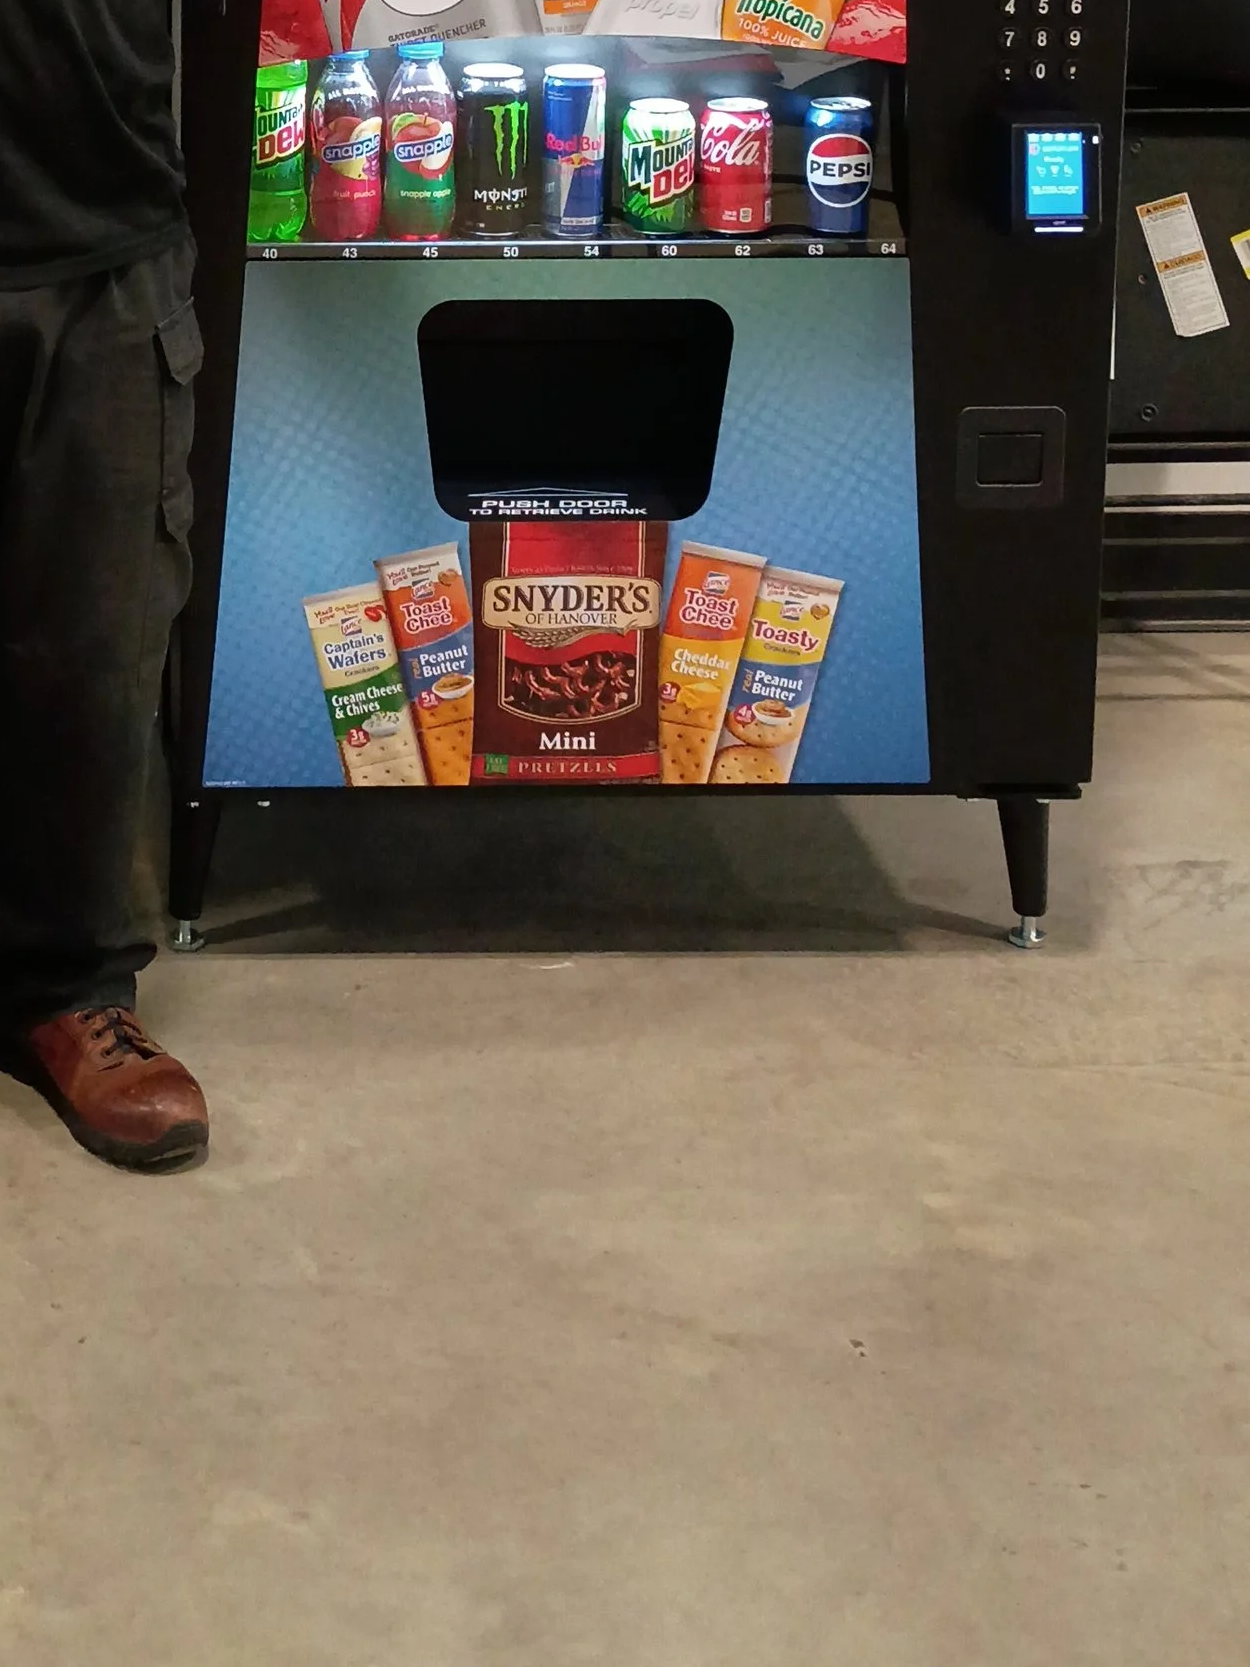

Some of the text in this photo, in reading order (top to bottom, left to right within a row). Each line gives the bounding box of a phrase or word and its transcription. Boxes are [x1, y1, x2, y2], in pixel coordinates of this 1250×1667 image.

[388, 25, 436, 43] GATORADE
[430, 18, 487, 42] QUENCHER
[738, 17, 809, 48] 100% JUICE
[1005, 30, 1081, 47] 7 8 9
[1035, 63, 1046, 79] 0
[325, 134, 380, 159] snapple
[398, 133, 453, 158] snapple
[546, 133, 578, 152] Red
[810, 159, 871, 178] PEPSI
[262, 248, 278, 259] 40
[342, 247, 358, 258] 43
[422, 247, 439, 258] 45
[503, 247, 519, 258] 50
[584, 245, 600, 257] 54
[661, 245, 678, 256] 60
[734, 245, 751, 256] 62
[808, 244, 824, 255] 63
[881, 242, 897, 254] 64
[469, 507, 649, 516] TO RETRIEVE DRINK
[481, 499, 628, 509] PUSH DOOR
[402, 597, 450, 618] Toast
[492, 581, 650, 614] SNYDER'S
[685, 589, 737, 615] Toast
[405, 612, 453, 632] Chee
[525, 612, 618, 626] OF HANOVER
[681, 605, 733, 630] Chee
[324, 633, 385, 655] Captain's
[752, 619, 820, 651] Toasty
[327, 649, 387, 670] Wafers
[419, 644, 469, 666] Peanut
[674, 648, 731, 671] Cheddar
[422, 658, 467, 678] Butter
[671, 659, 719, 680] Cheese
[754, 669, 804, 691] Peanut
[331, 682, 403, 708] Cream Cheese
[751, 682, 796, 702] Butter
[335, 700, 381, 720] & Chives
[539, 732, 597, 751] Mini
[518, 761, 618, 774] PRETZELS
